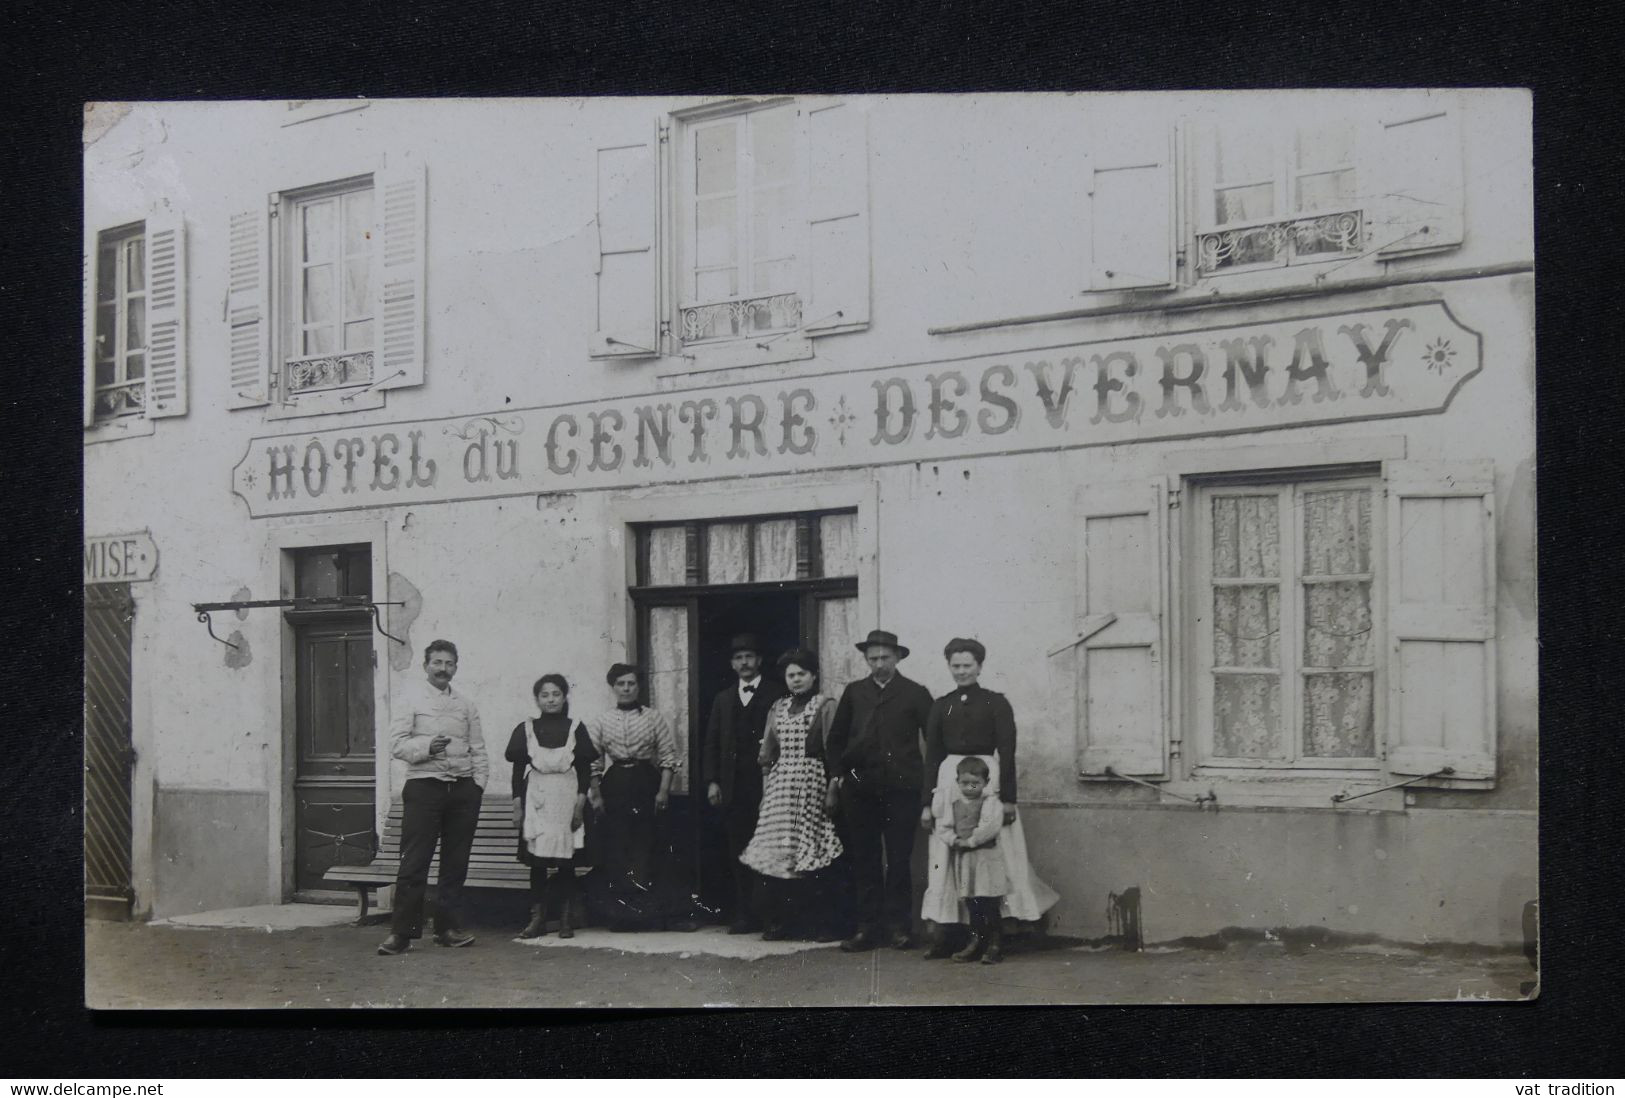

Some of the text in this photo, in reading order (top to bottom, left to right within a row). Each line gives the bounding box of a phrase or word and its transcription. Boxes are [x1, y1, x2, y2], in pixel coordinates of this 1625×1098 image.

[266, 318, 1413, 500] HÔTEL du CENTRE DESVERNAY
